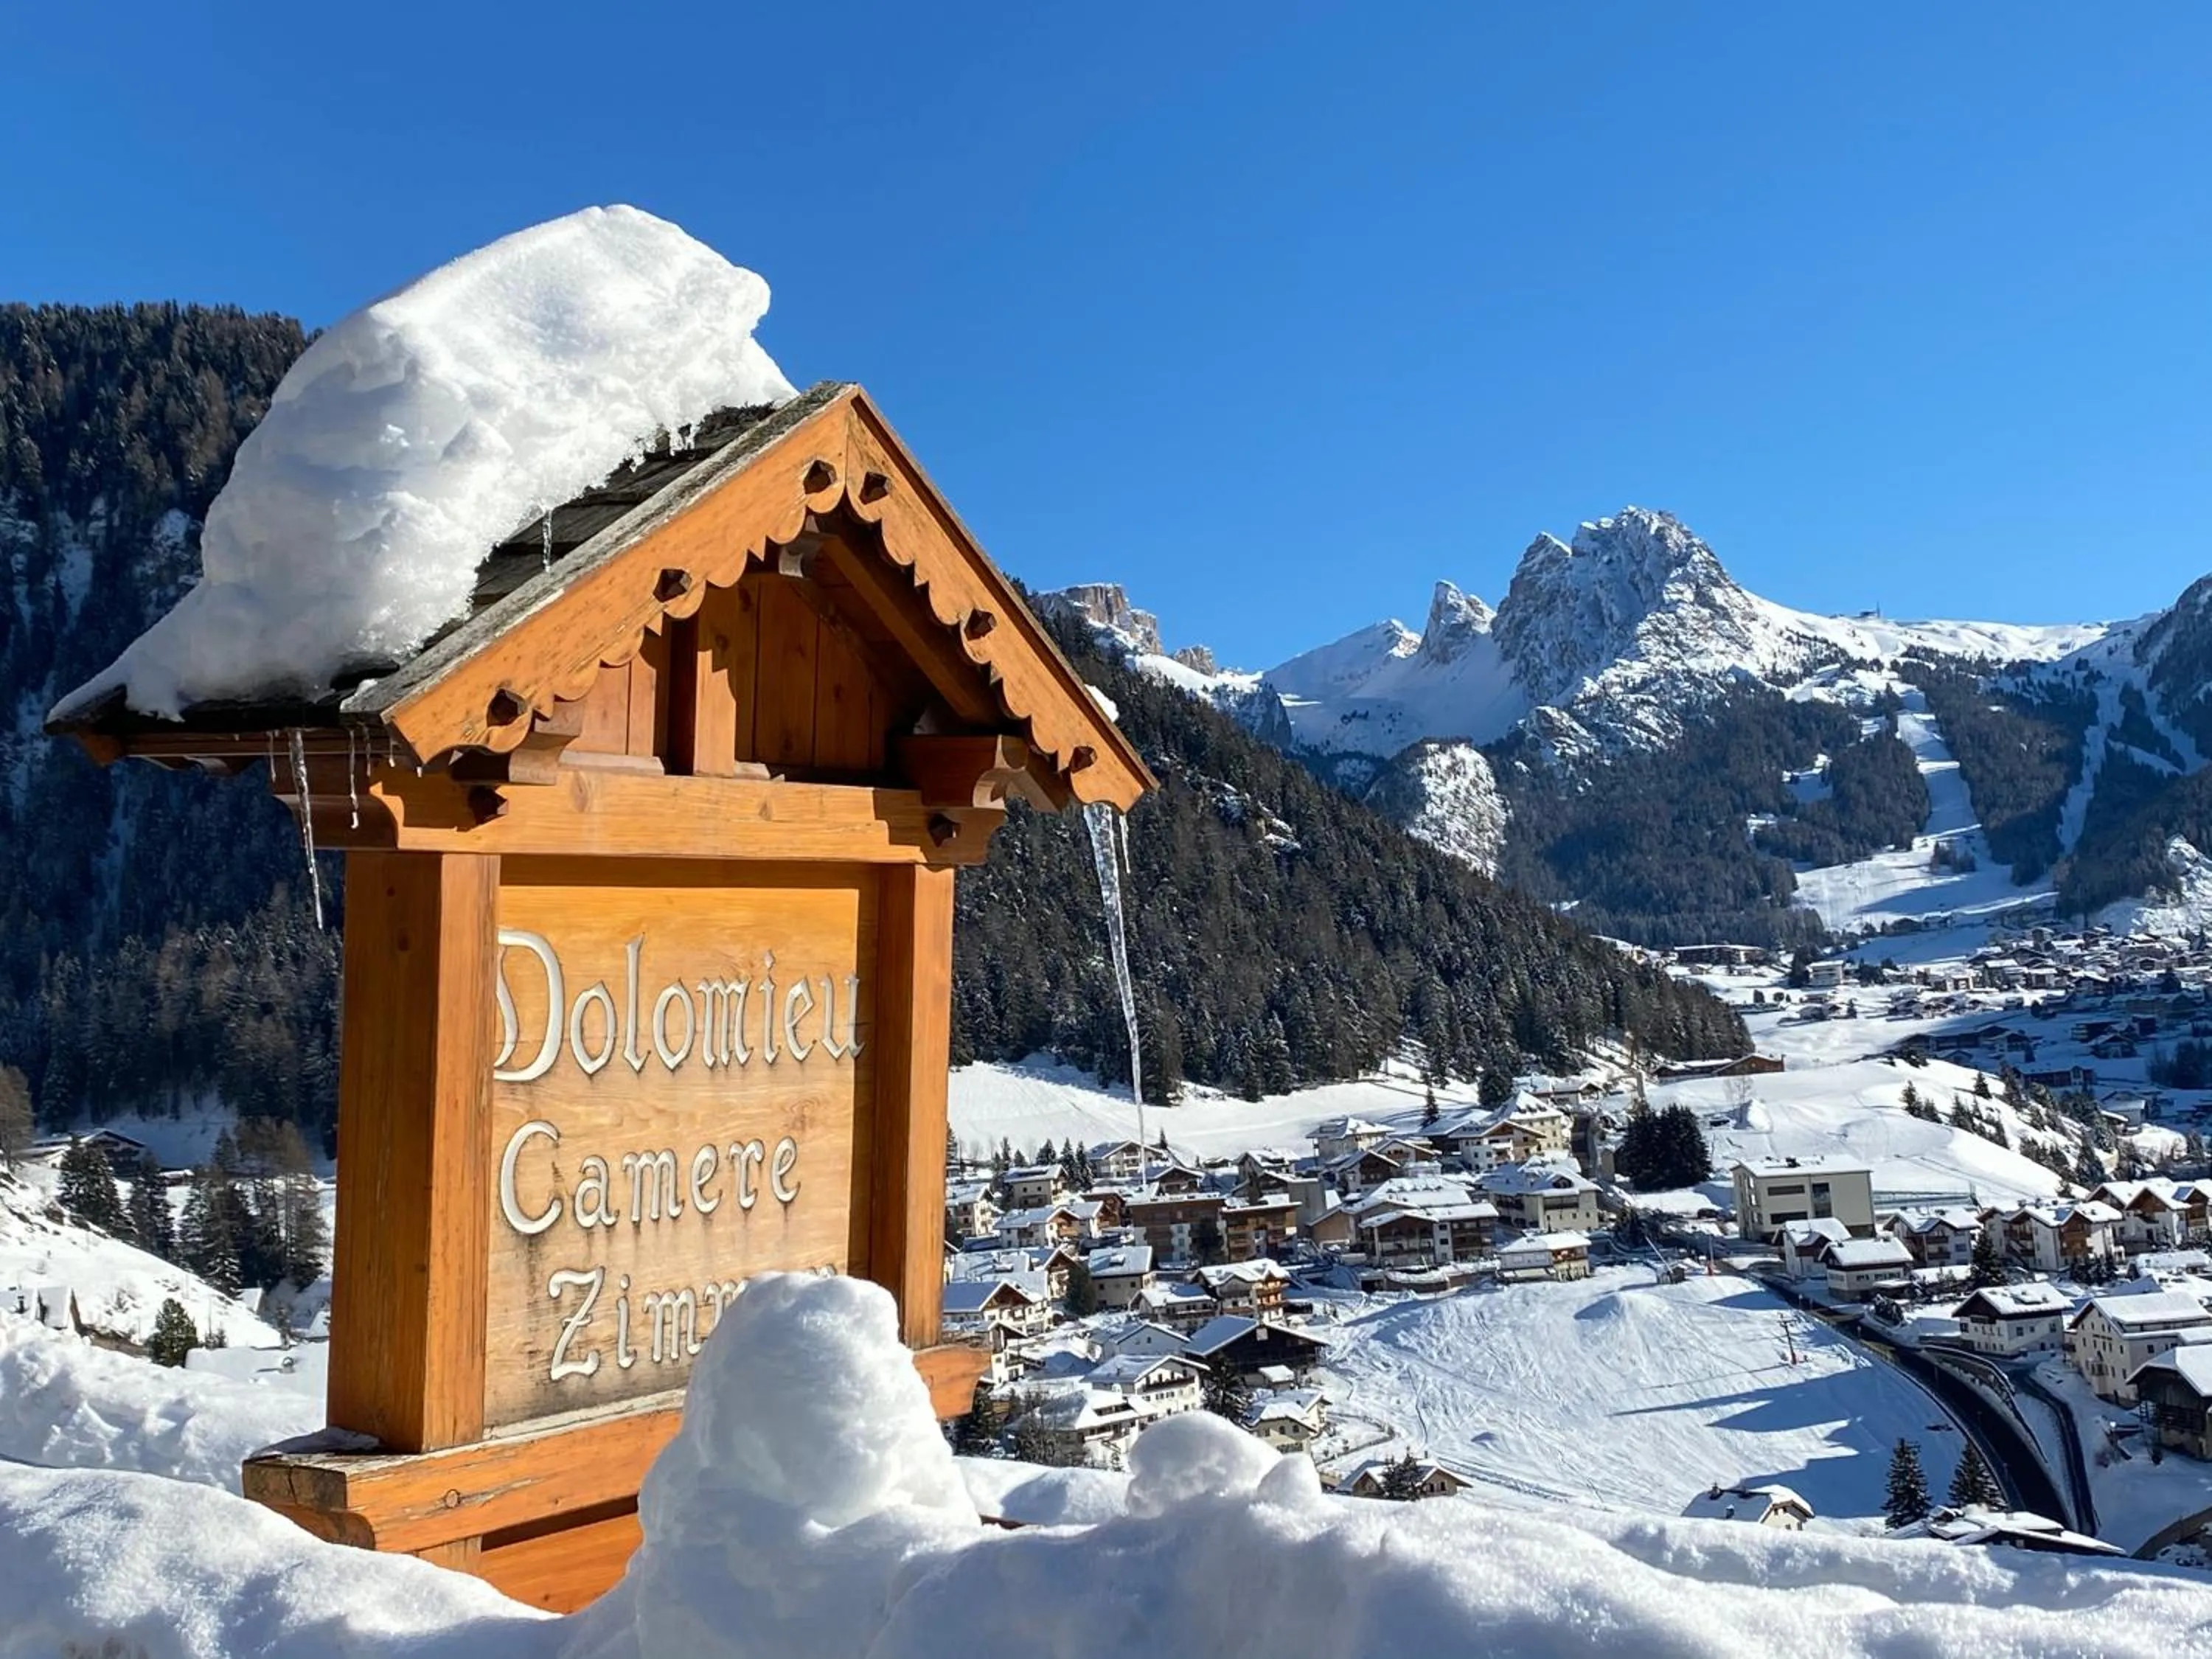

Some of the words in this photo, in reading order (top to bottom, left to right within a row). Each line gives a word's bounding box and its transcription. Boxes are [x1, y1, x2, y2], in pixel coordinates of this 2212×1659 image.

[494, 929, 866, 1081] Dolomieu
[499, 1120, 800, 1235] Camere
[548, 1263, 837, 1381] Zim
